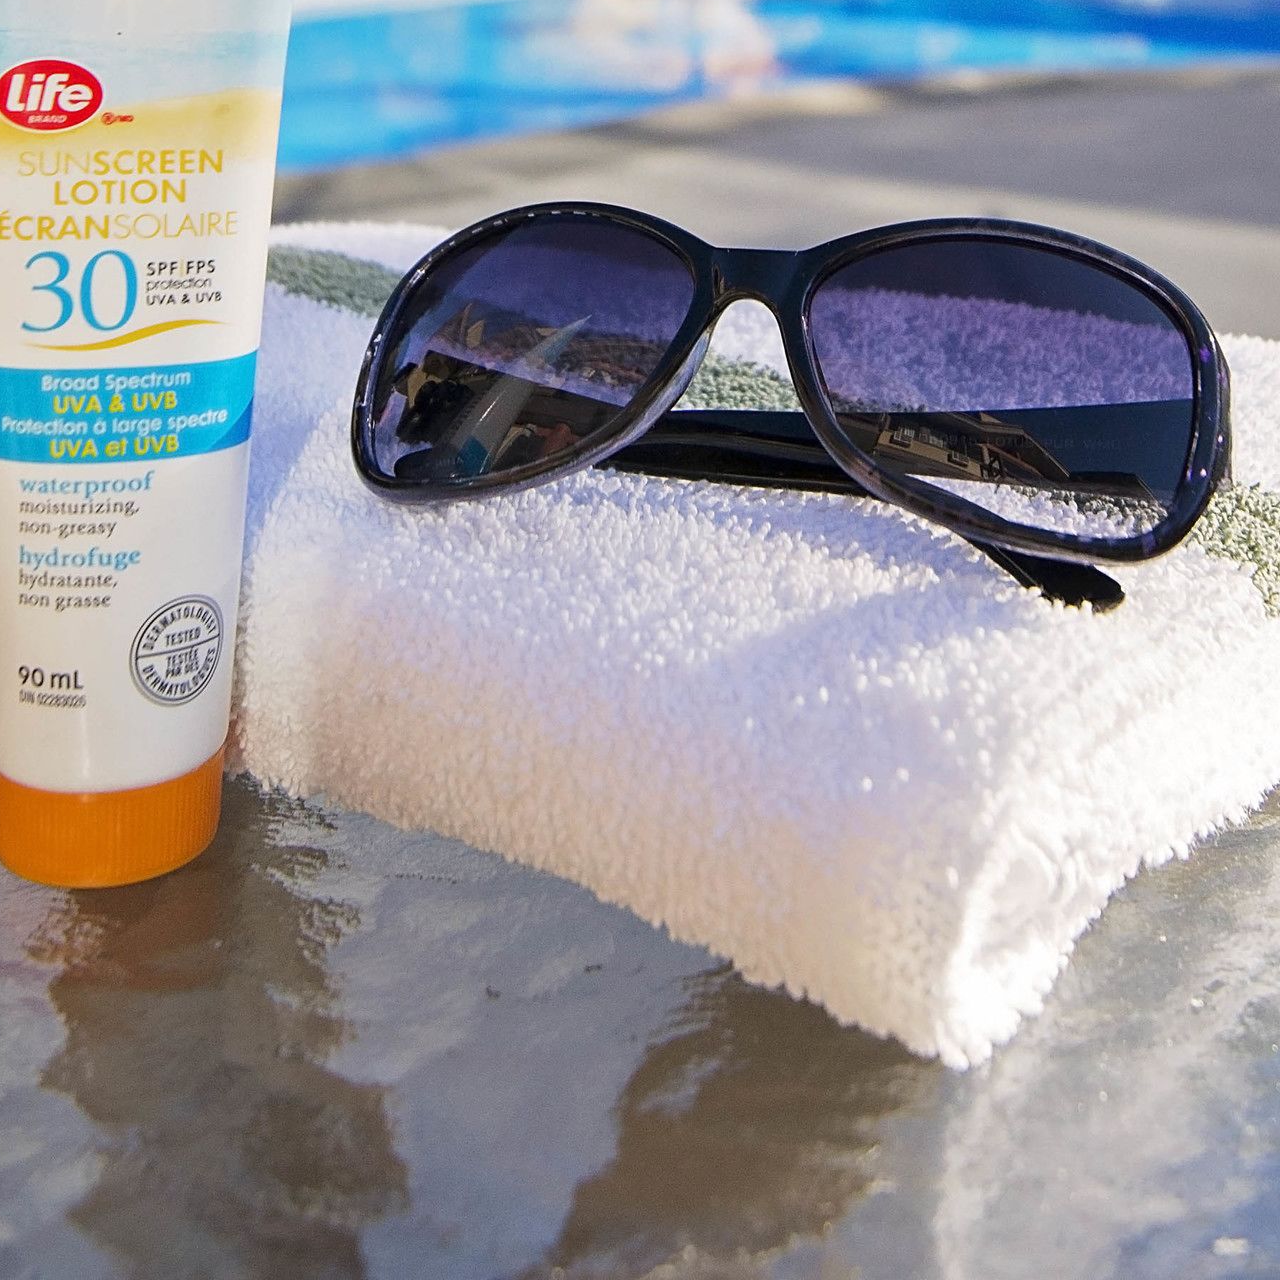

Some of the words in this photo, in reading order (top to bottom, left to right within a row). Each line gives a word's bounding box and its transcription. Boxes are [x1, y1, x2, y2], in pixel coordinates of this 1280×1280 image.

[6, 73, 93, 112] Life
[19, 149, 224, 176] SUNSCREEN
[54, 179, 187, 205] LOTION
[147, 261, 178, 276] SPF
[186, 260, 216, 275] FPS
[21, 249, 138, 333] 30
[146, 277, 212, 293] protection
[146, 294, 176, 306] UVA
[181, 293, 191, 304] &
[196, 291, 222, 303] UVB
[41, 375, 99, 392] Broad
[105, 371, 192, 394] Spectrum
[53, 394, 102, 414] UVA
[108, 393, 125, 413] &
[131, 390, 178, 412] UVB
[1, 416, 88, 436] Protection
[93, 418, 107, 435] à
[111, 416, 162, 437] large
[167, 408, 228, 433] spectre
[49, 439, 98, 459] UVA
[104, 437, 127, 457] et
[134, 434, 180, 456] UVB
[20, 470, 155, 499] waterproof
[19, 498, 140, 517] moisturizing,
[19, 521, 117, 539] non-greasy
[19, 545, 141, 570] hydrofuge
[19, 568, 118, 589] hydratante,
[19, 593, 50, 607] non
[55, 595, 111, 613] grasse
[166, 627, 201, 647] TESTED
[18, 666, 45, 687] 90
[50, 670, 84, 690] mL
